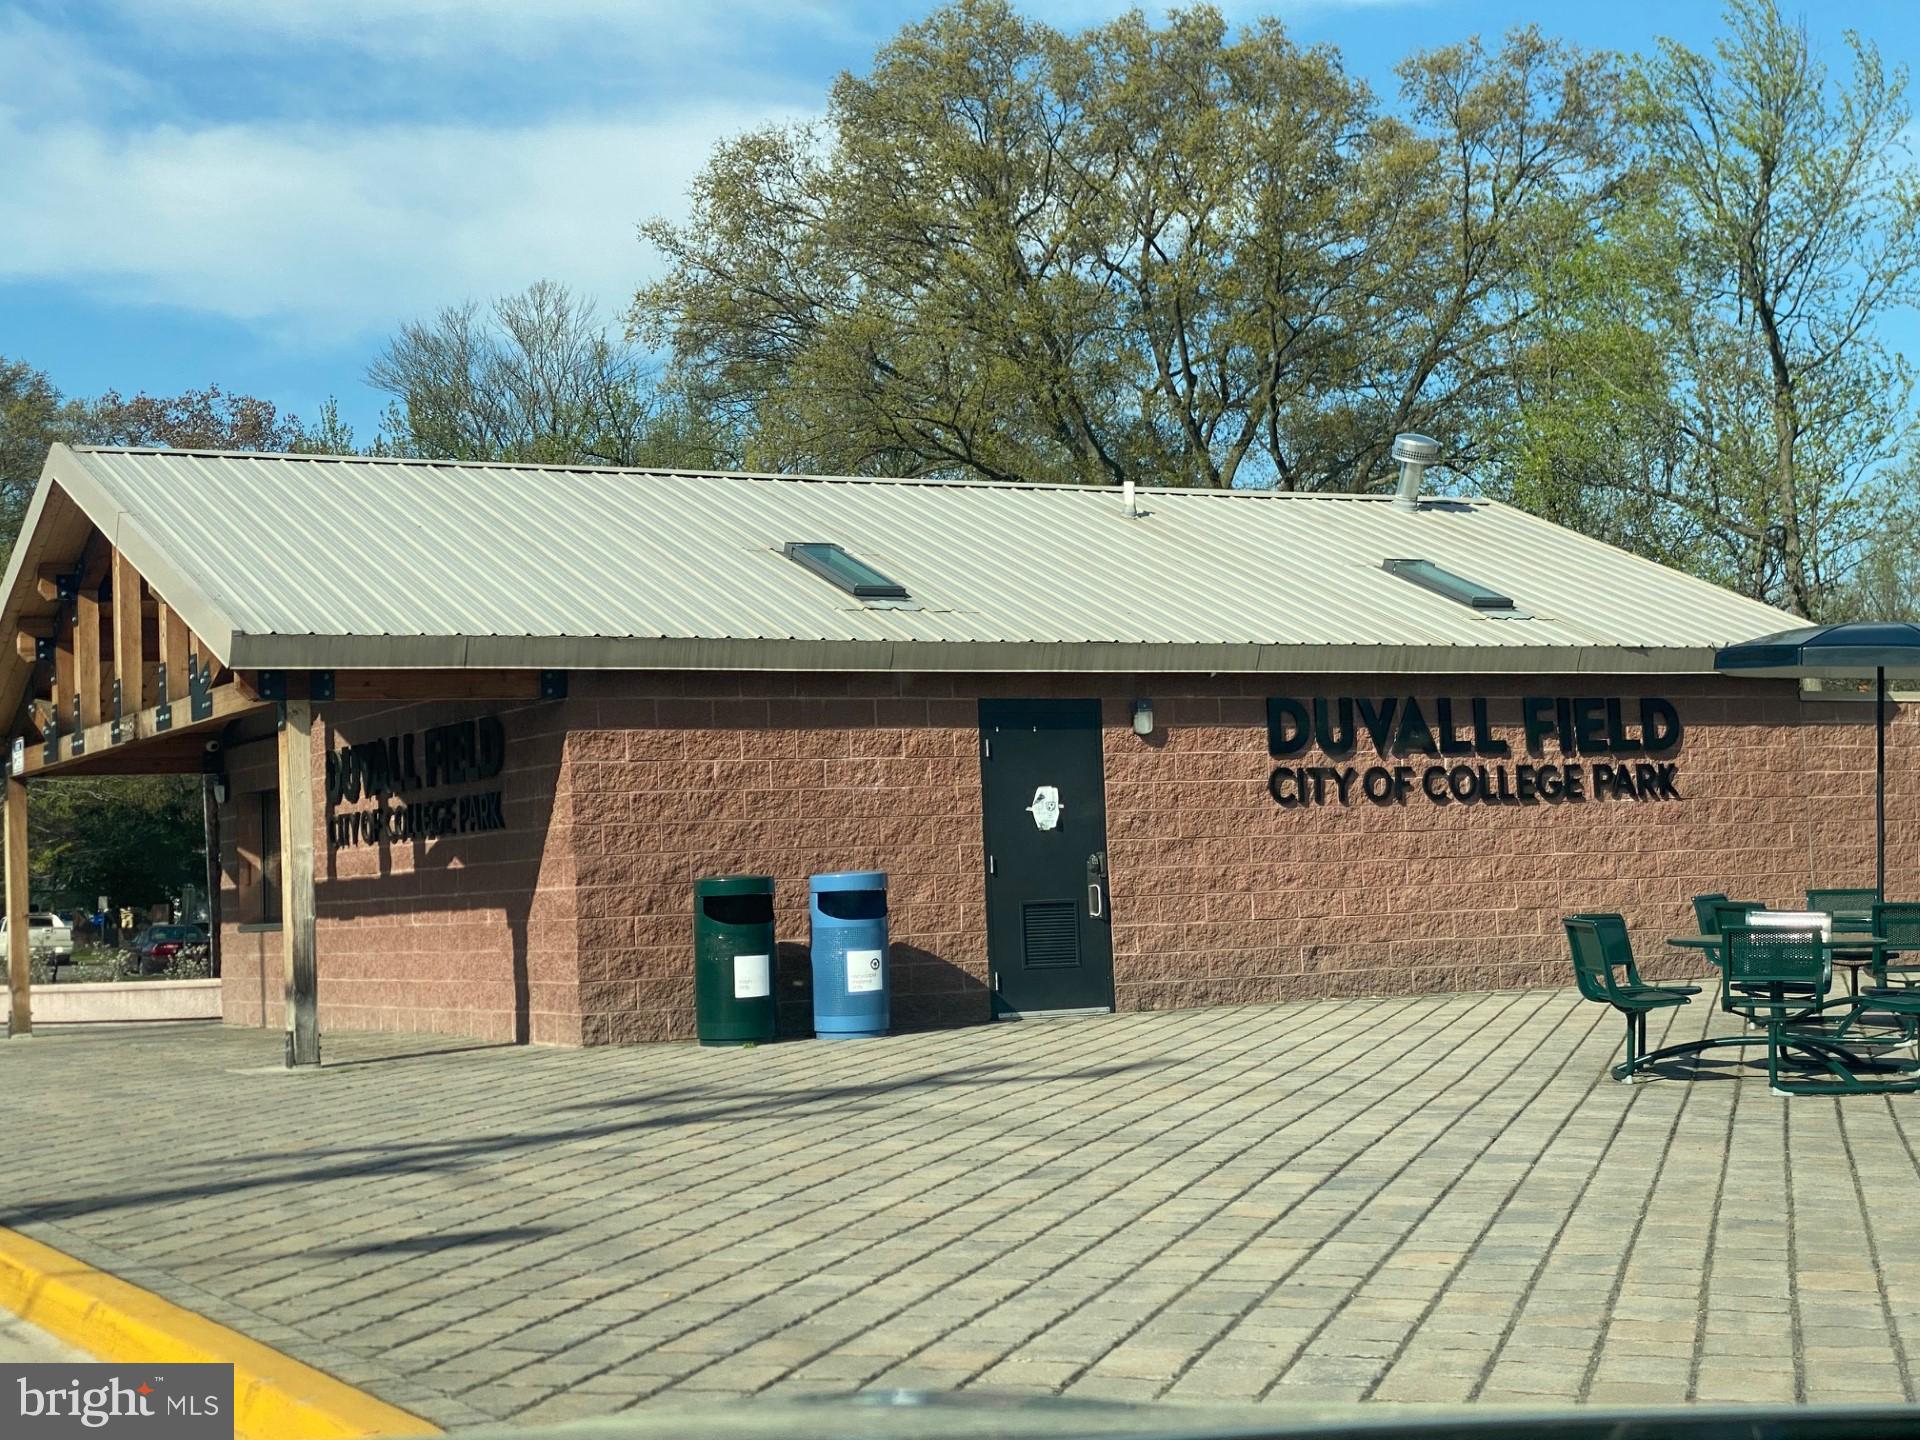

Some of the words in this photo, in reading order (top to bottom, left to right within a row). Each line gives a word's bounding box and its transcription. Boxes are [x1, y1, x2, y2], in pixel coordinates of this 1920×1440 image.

[1266, 697, 1511, 757] DUVALL
[1523, 697, 1681, 756] FIELD
[327, 733, 422, 803] DUVALL
[425, 717, 504, 785] FIELD
[1269, 766, 1357, 804] CITY
[1363, 766, 1414, 803] OF
[1422, 764, 1584, 803] COLLEGE
[1592, 763, 1680, 802] PARK
[387, 798, 457, 843] COLLEGE
[459, 791, 505, 832] PARK
